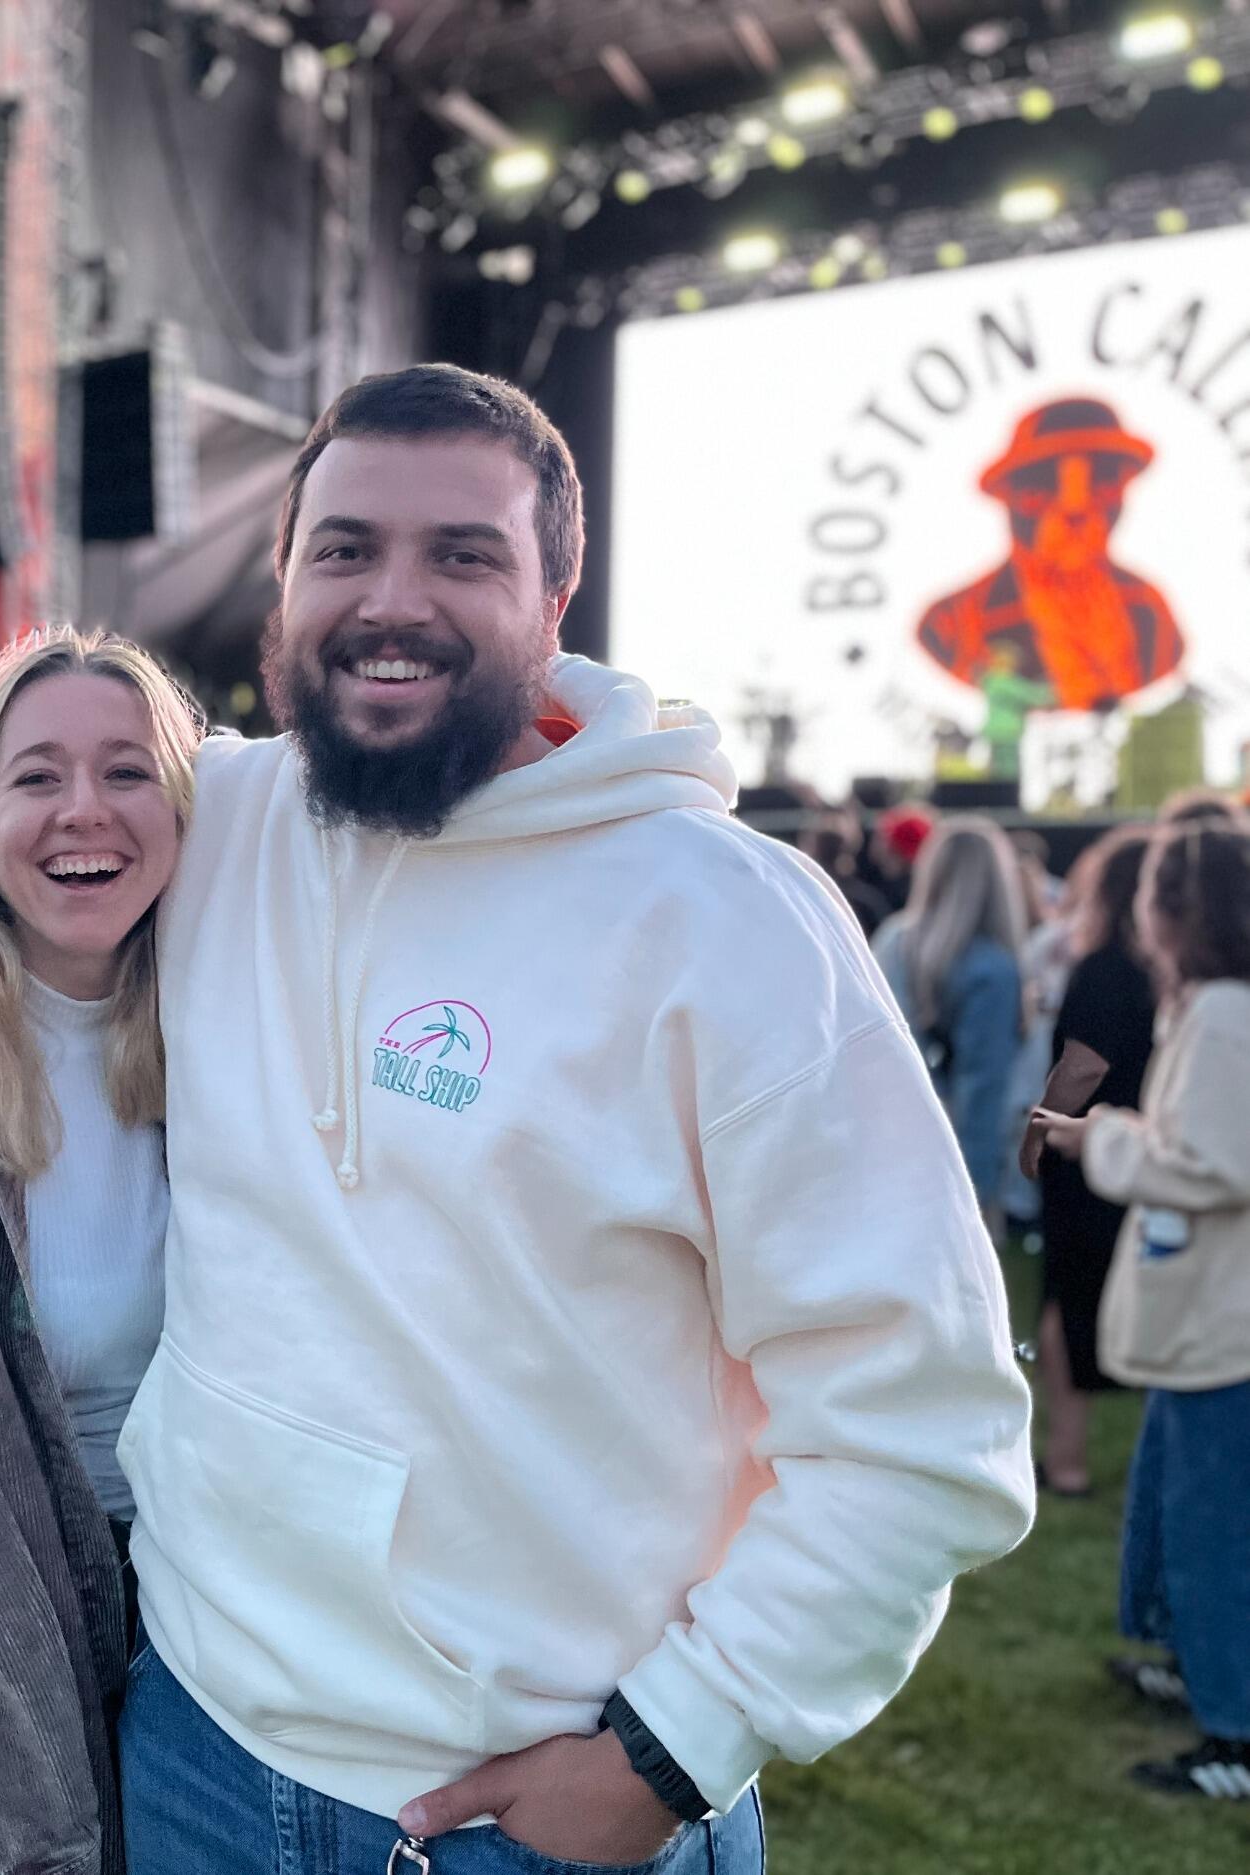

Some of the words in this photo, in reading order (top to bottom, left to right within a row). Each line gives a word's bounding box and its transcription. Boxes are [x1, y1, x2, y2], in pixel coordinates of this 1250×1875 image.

[805, 291, 1040, 613] BOSTON
[372, 1047, 421, 1096] TALL
[418, 1065, 481, 1113] SHIP
